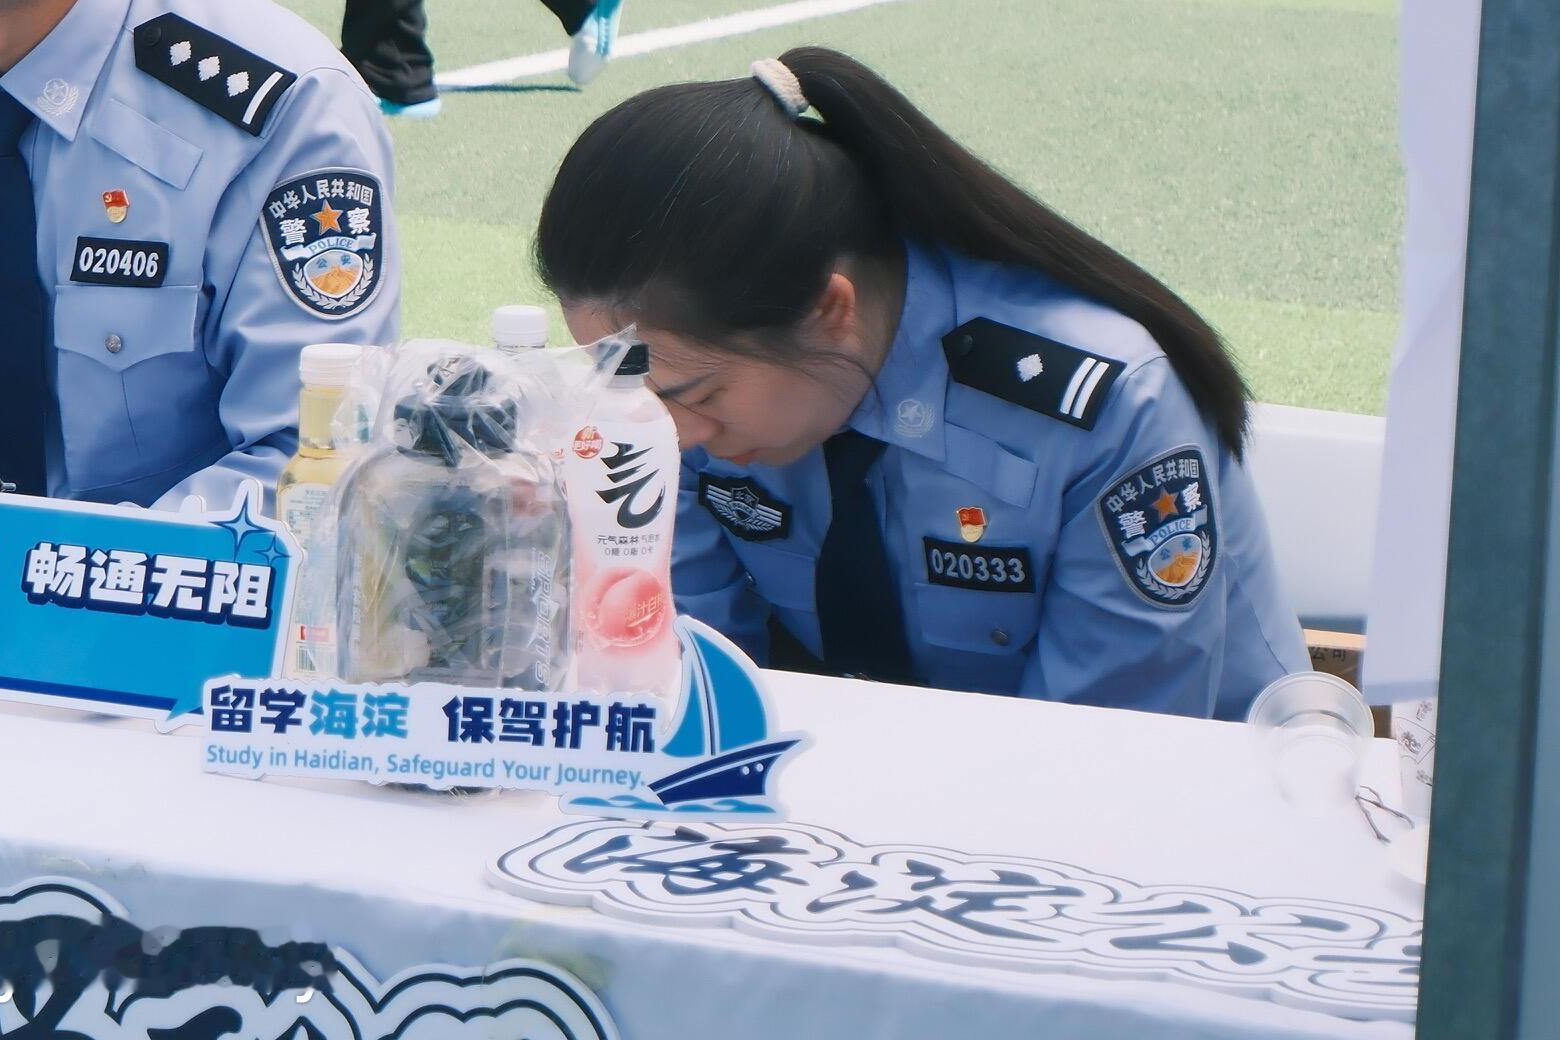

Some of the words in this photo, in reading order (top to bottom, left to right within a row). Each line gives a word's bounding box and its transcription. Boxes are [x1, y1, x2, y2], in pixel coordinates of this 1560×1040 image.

[268, 178, 374, 219] 中华人民共和国
[78, 246, 159, 278] 020406
[308, 237, 355, 254] POLICE
[1106, 459, 1200, 513] 中华人民共和国
[1149, 518, 1193, 547] POLICE
[24, 542, 273, 627] 畅通无阻
[931, 548, 1026, 583] 020333
[210, 684, 411, 740] 留学海淀
[441, 695, 657, 753] 保驾护航
[207, 744, 263, 769] Study
[270, 747, 287, 767] in
[294, 748, 380, 775] Haidian,
[386, 753, 496, 780] Safeguard
[502, 760, 551, 781] Your
[554, 763, 645, 790] Journey.
